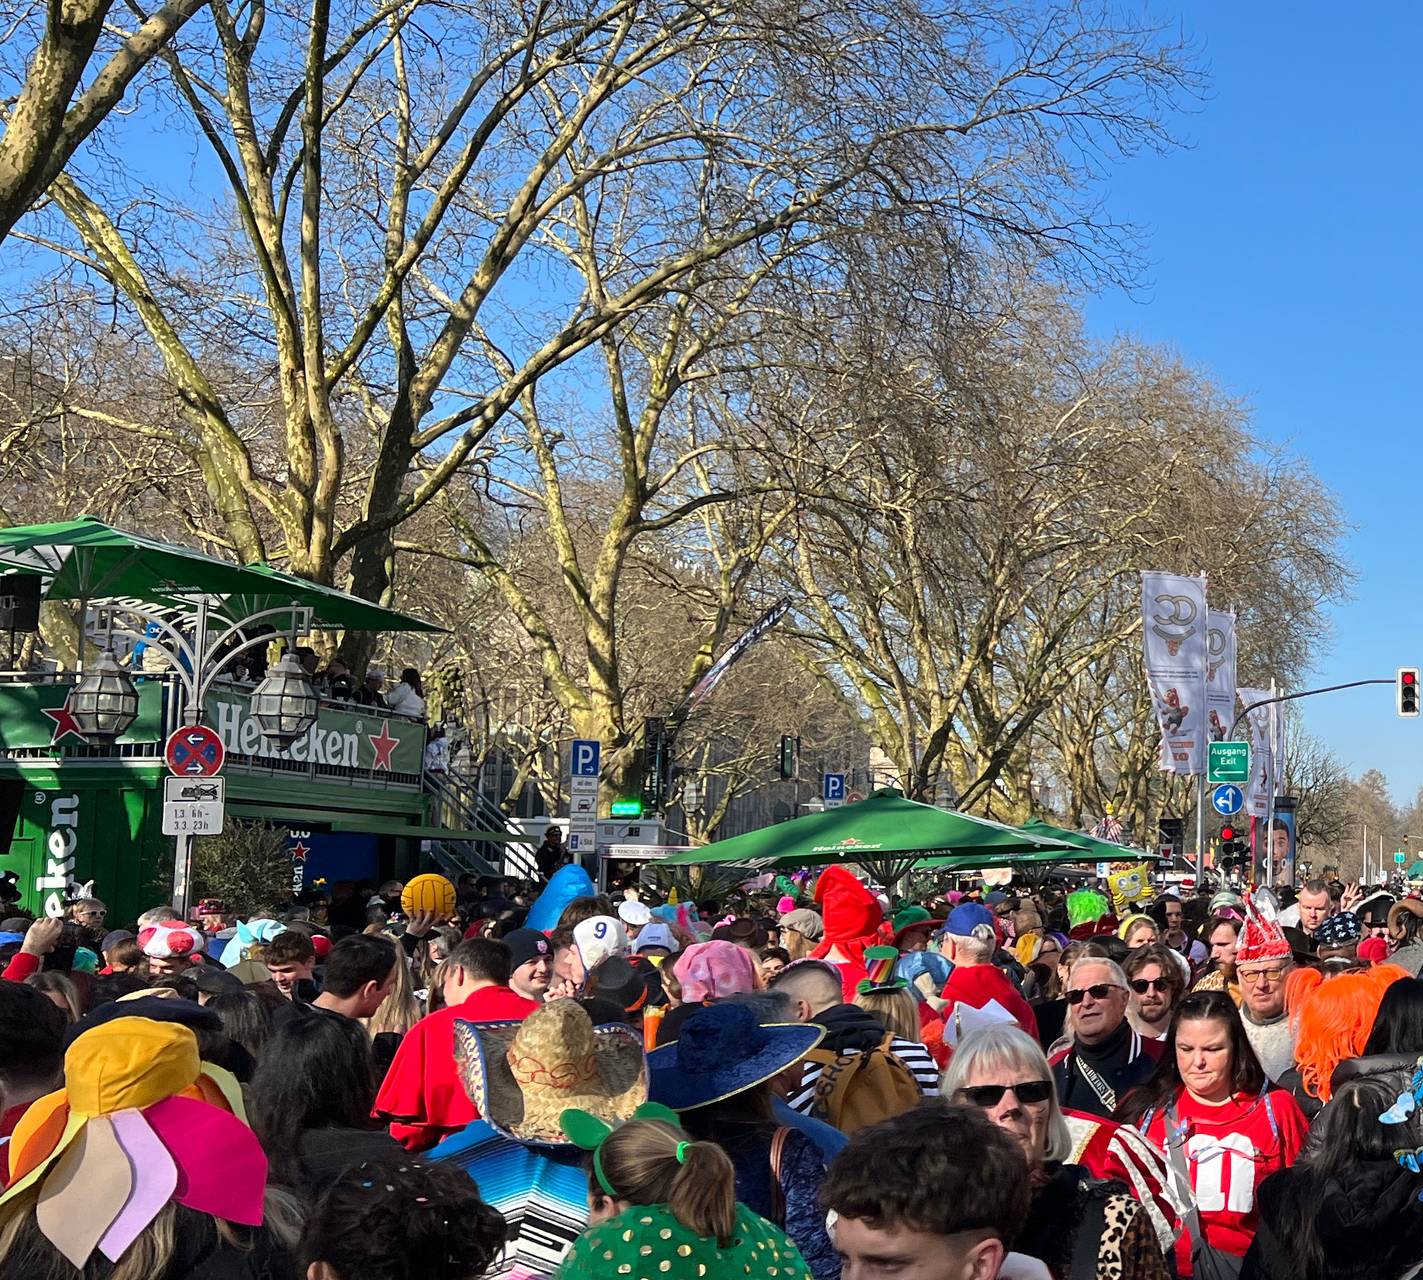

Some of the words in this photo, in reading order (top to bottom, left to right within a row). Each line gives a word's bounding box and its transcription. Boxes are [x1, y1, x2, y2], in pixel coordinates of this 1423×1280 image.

[1211, 747, 1246, 756] Ausgang
[578, 745, 594, 774] P
[1221, 757, 1236, 765] Exit
[829, 776, 840, 798] P
[192, 809, 202, 818] 6h
[193, 821, 209, 830] 23h
[812, 843, 883, 852] Heineken
[594, 922, 607, 939] 9
